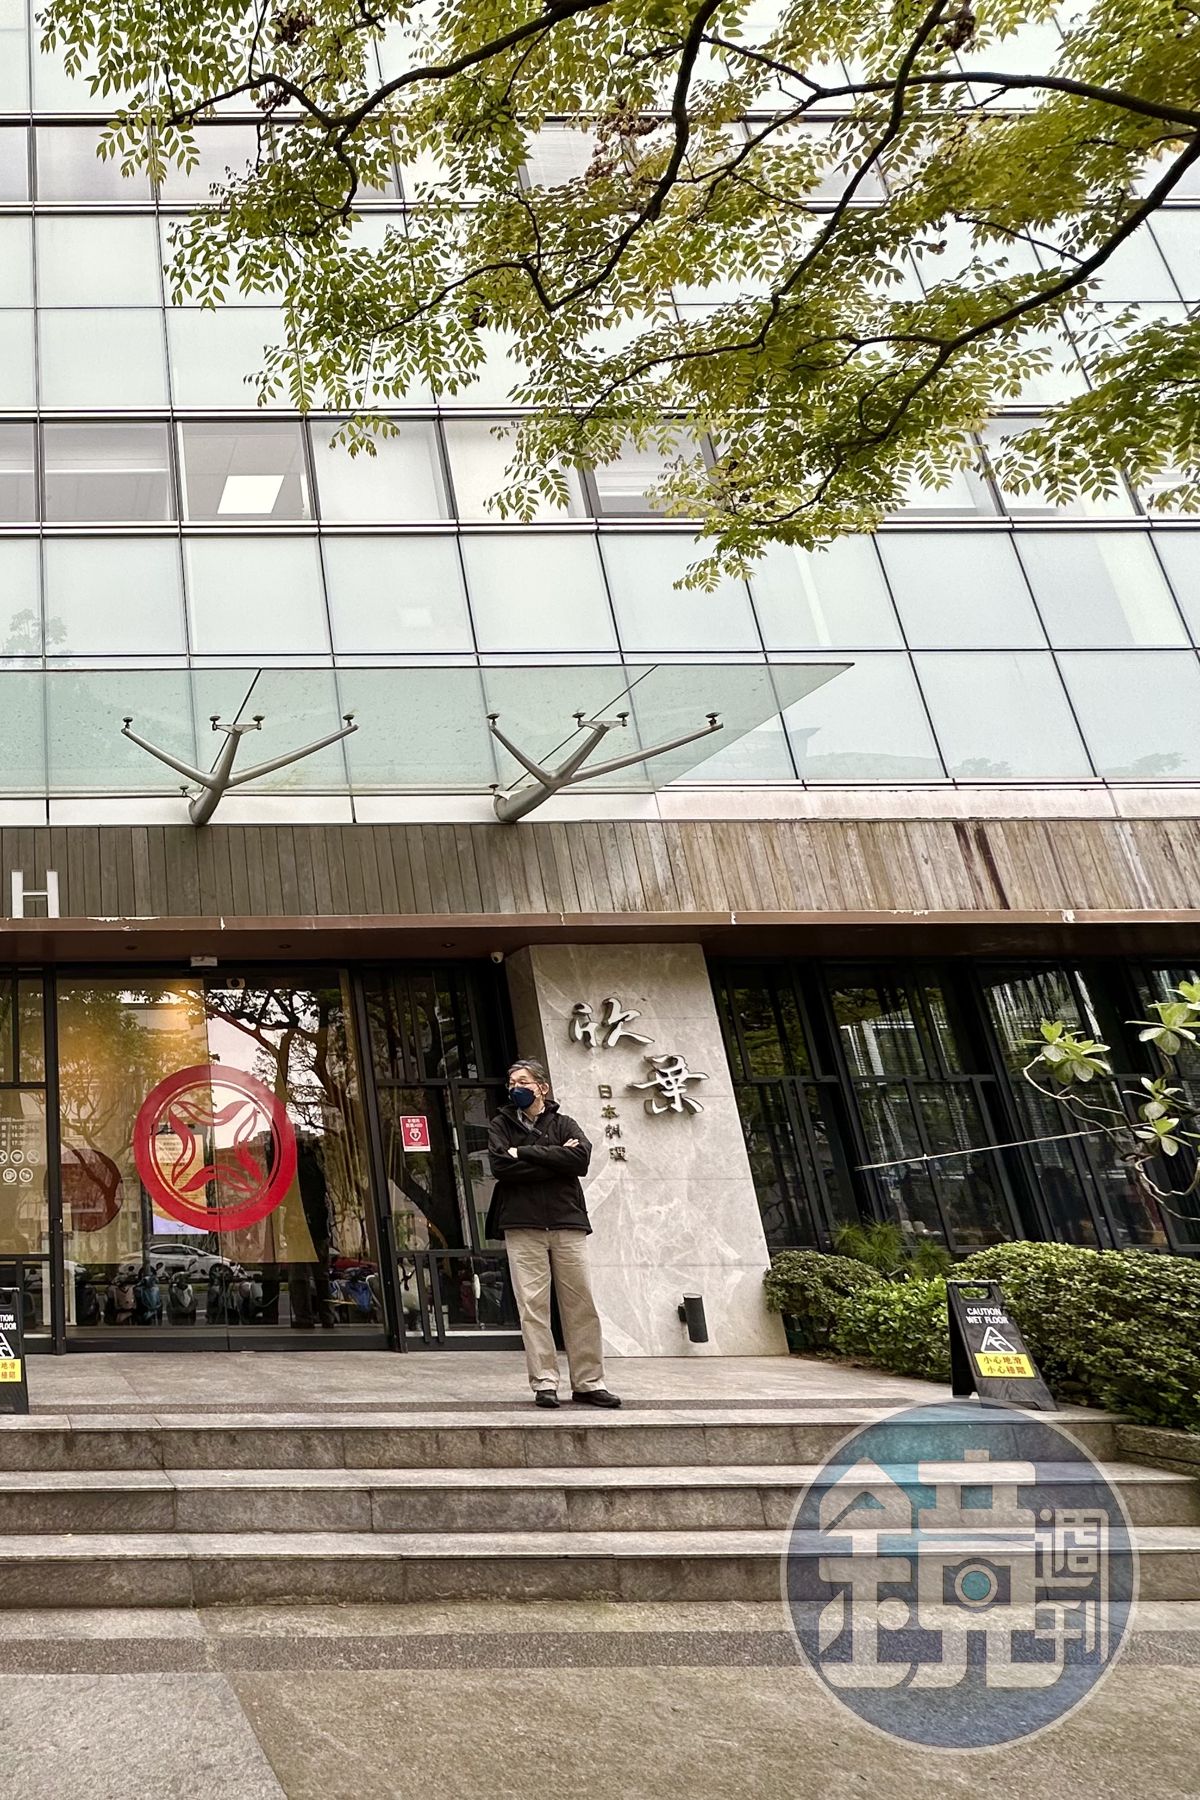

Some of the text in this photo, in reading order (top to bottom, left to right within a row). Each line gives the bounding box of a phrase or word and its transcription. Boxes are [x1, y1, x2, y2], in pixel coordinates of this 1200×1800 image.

[598, 1084, 628, 1162] 日本料理
[966, 1307, 1002, 1316] CAUTION
[965, 1316, 1009, 1324] WET FLOOR
[983, 1356, 1022, 1365] 小心地滑
